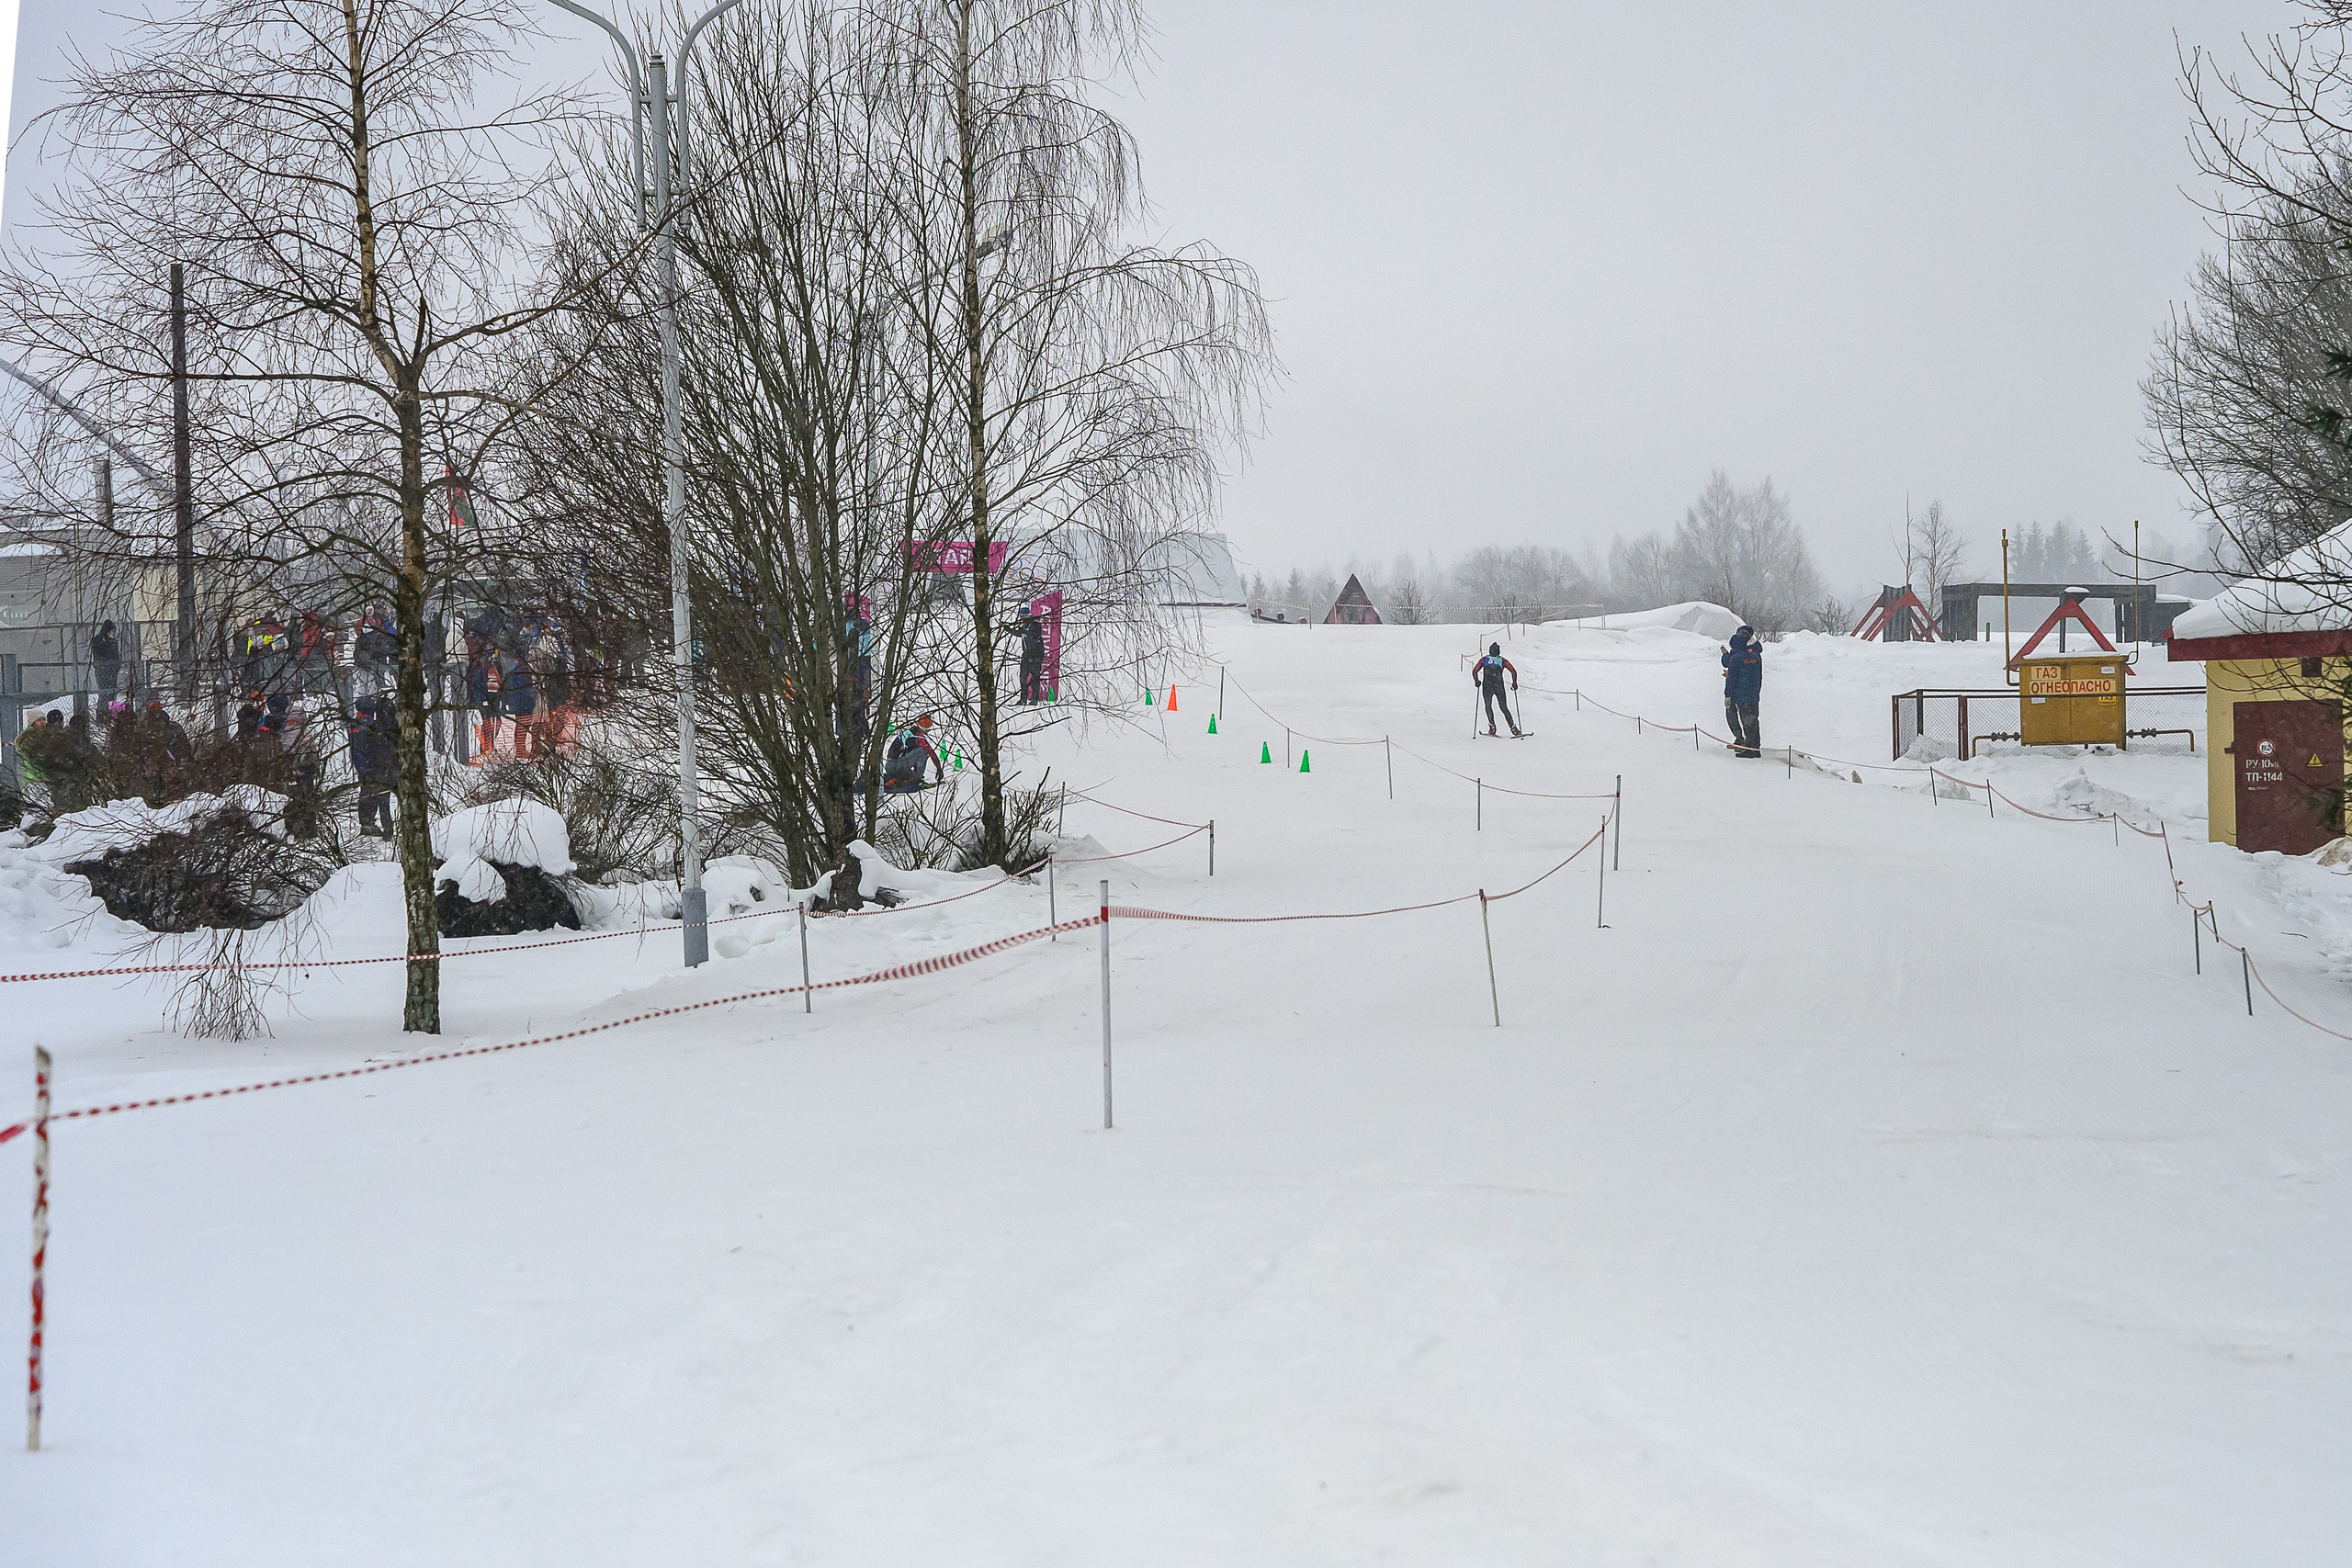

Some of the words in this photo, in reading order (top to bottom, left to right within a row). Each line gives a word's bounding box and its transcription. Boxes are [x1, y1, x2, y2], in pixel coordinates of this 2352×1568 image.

[2036, 667, 2058, 679] ГАЗ
[2030, 680, 2111, 694] ОГНЕОПАСНО
[2245, 772, 2283, 782] ТП-1144
